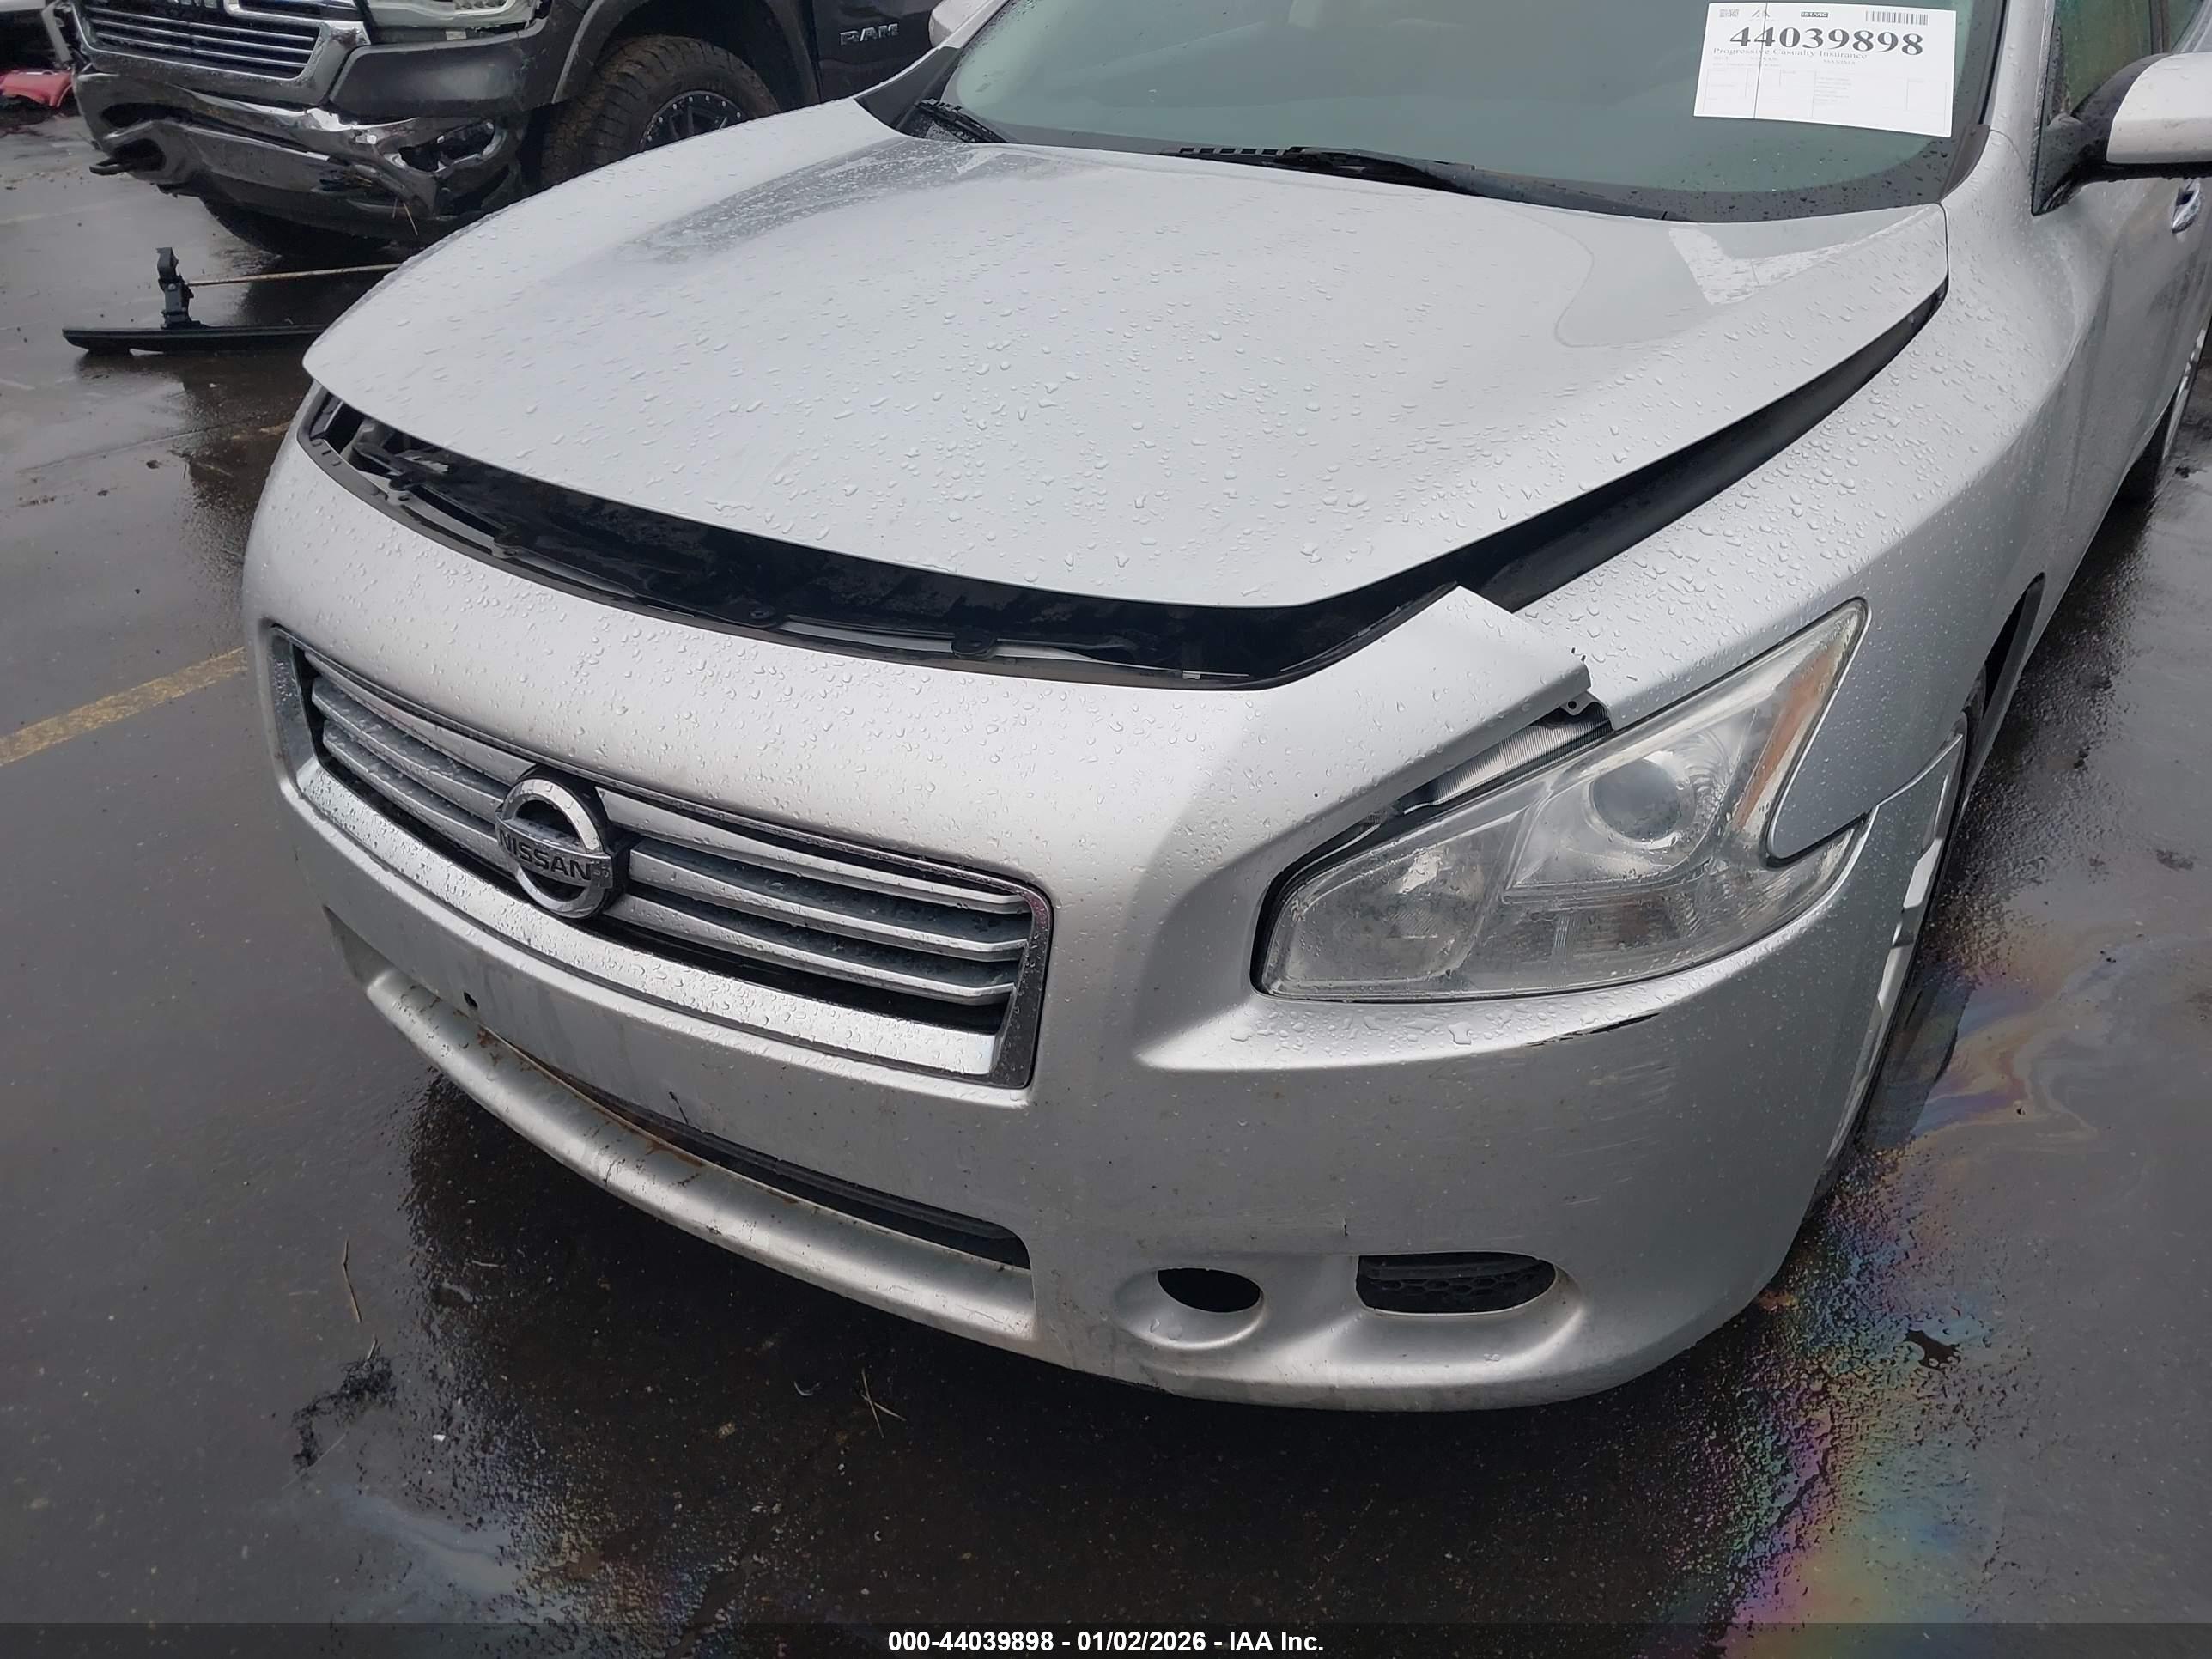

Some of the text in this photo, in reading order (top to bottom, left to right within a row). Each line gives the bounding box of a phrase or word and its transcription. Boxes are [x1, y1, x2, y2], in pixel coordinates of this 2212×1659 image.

[840, 22, 899, 46] RAM
[1729, 27, 1923, 56] 44039898
[1819, 50, 1868, 59] Insurance
[499, 829, 592, 881] NISSAN
